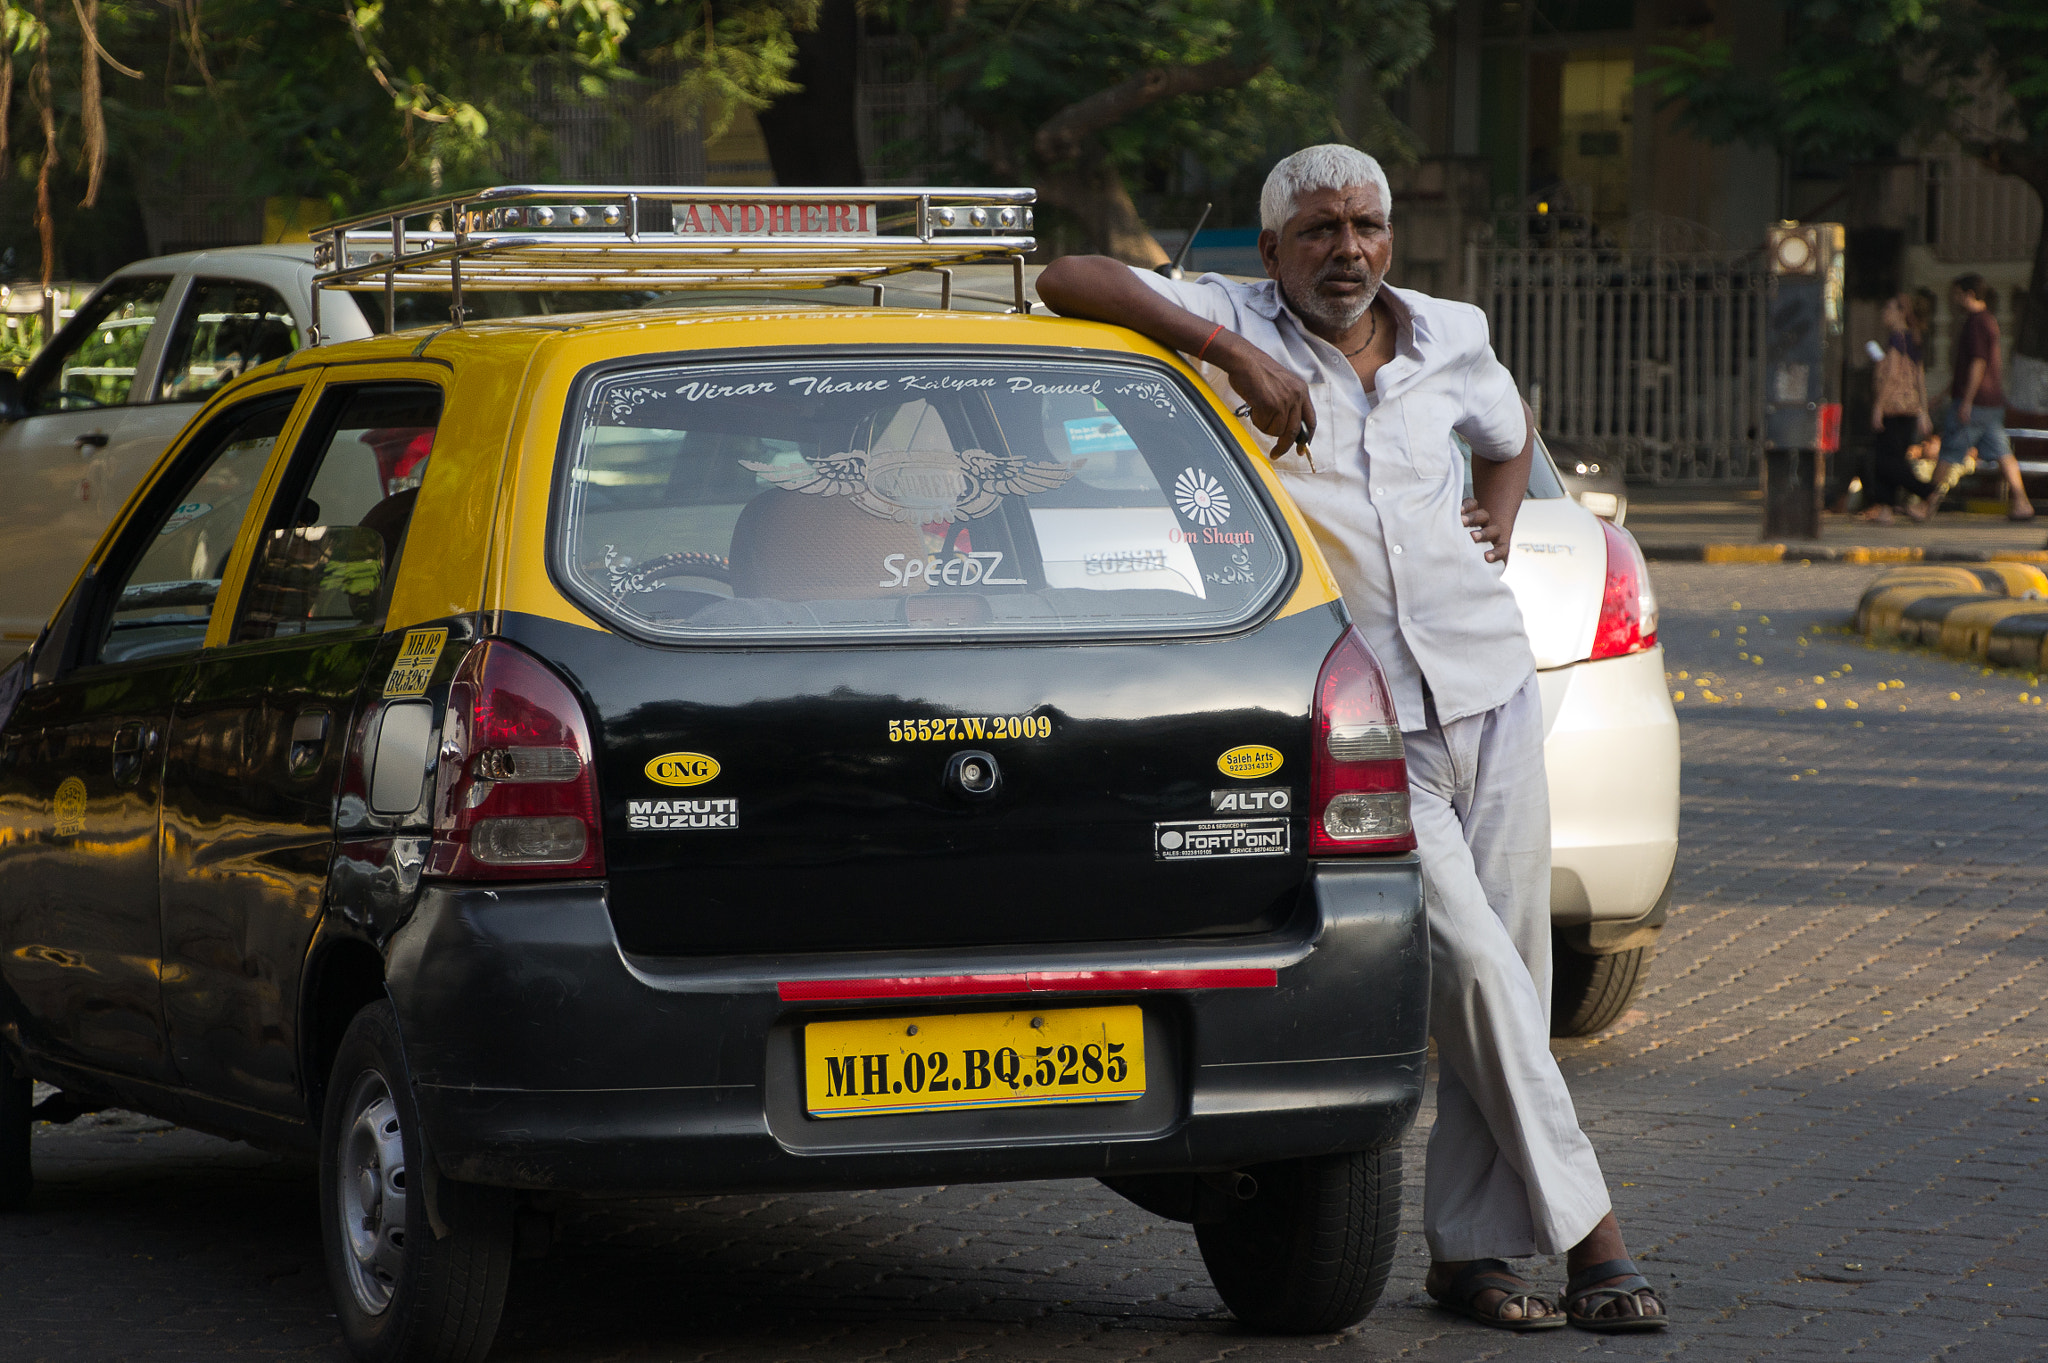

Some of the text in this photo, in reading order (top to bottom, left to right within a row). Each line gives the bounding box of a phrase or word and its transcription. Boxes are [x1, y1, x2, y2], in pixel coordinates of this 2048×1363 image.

[681, 204, 870, 233] ANDHERI
[675, 375, 1103, 401] Virar Thane Kalyan Panvel
[1168, 527, 1198, 544] Om
[403, 633, 442, 656] MH.02
[888, 716, 1052, 742] 55527.W.2009
[1226, 752, 1274, 765] Saleh Arts
[656, 761, 708, 778] CNG
[629, 799, 736, 814] MARUTI
[1216, 791, 1289, 811] ALTO
[62, 825, 79, 835] TAXI
[630, 814, 736, 828] SUZUKI
[824, 1042, 1128, 1097] MH.02.BQ.5285
